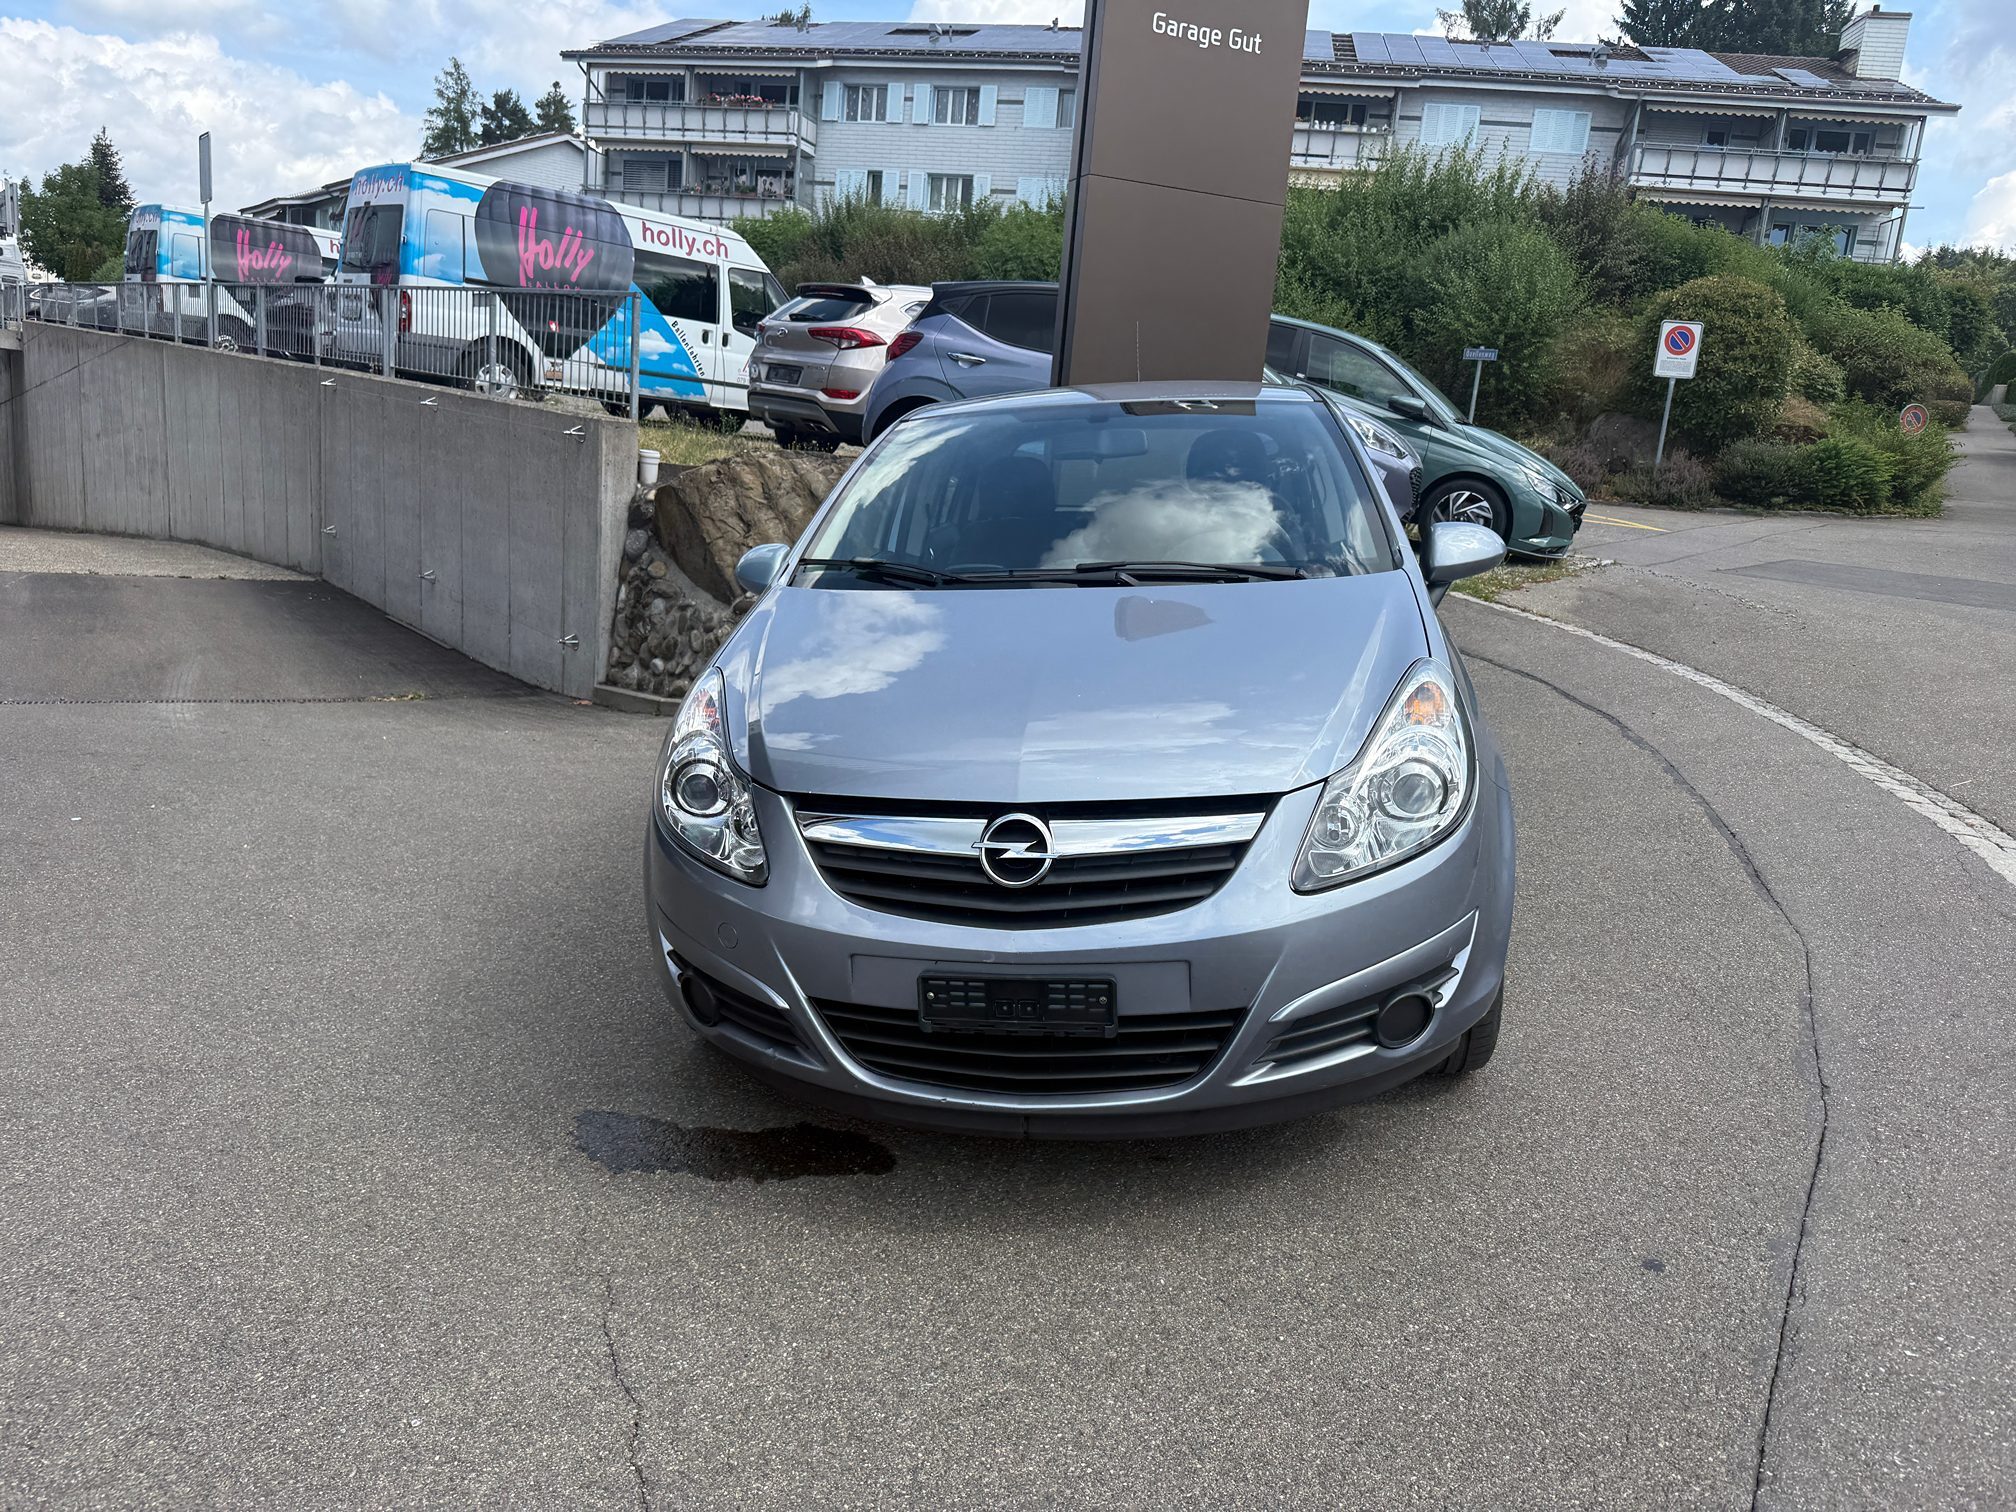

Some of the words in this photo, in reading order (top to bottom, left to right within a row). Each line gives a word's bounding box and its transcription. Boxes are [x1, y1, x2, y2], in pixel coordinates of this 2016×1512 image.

[1152, 12, 1222, 48] Garage
[1229, 28, 1262, 54] Gut
[236, 228, 292, 282] Holly
[518, 206, 595, 287] Holly
[641, 221, 729, 257] holly.ch
